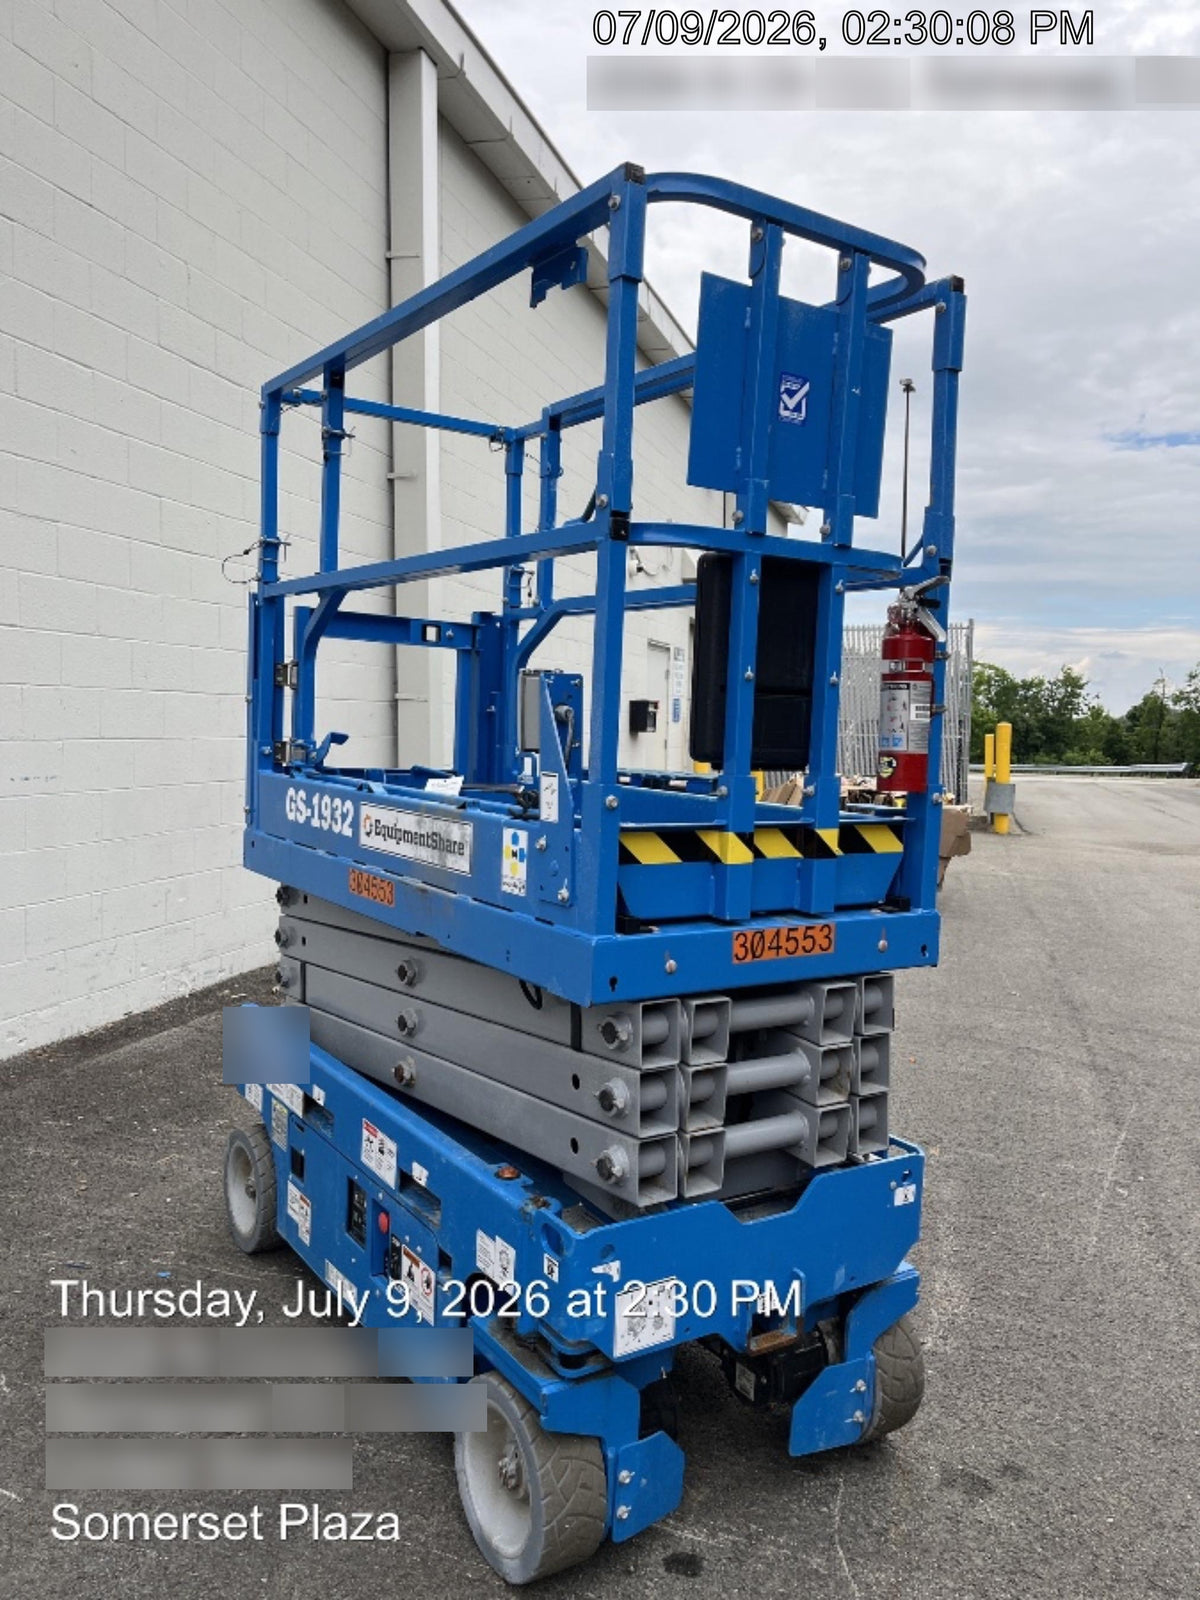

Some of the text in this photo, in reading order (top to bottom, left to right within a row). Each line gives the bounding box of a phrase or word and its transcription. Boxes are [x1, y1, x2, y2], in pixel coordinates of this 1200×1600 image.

[286, 787, 354, 837] GS-1932
[374, 819, 465, 856] EquipmentShare
[735, 924, 833, 961] 304553
